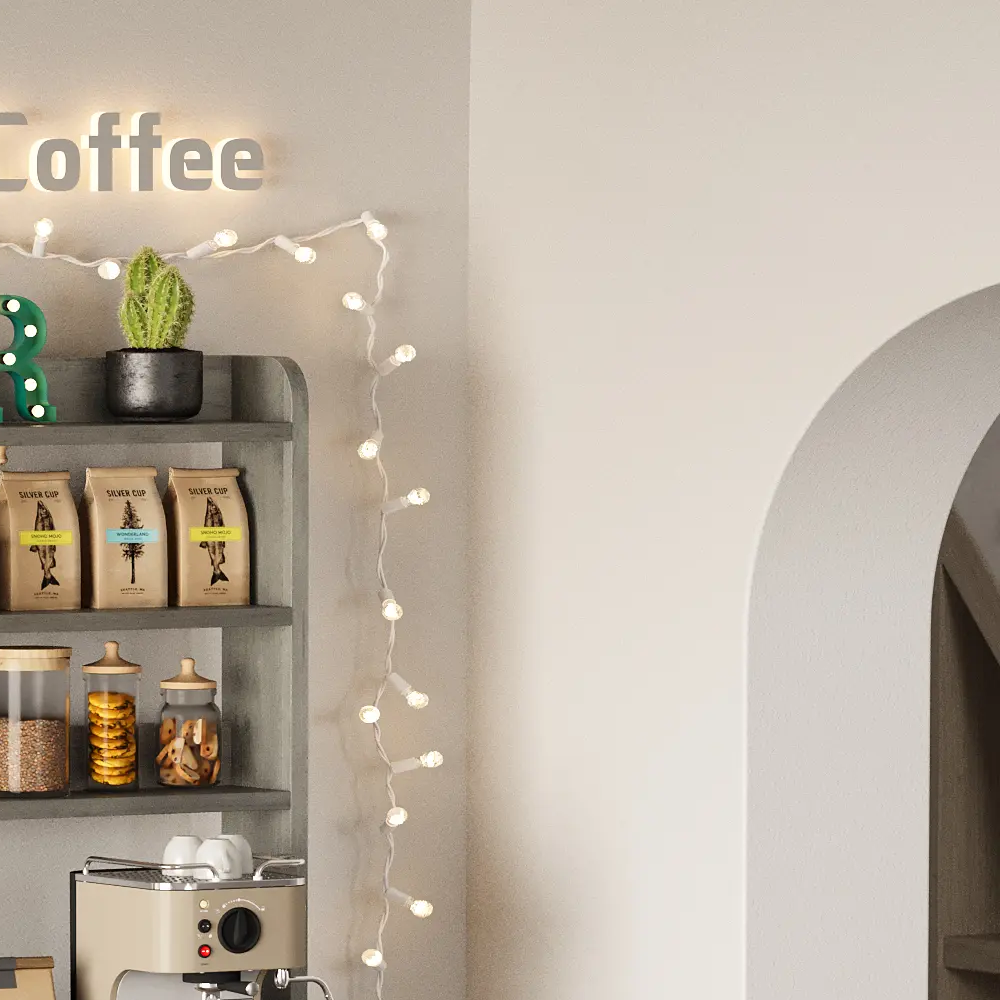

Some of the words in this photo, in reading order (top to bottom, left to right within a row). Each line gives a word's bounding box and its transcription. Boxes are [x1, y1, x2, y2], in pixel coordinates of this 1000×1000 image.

[19, 491, 43, 499] SILVER
[45, 490, 59, 498] CUP
[107, 489, 131, 497] SILVER
[132, 489, 146, 497] CUP
[188, 487, 213, 495] SILVER
[214, 487, 228, 495] CUP
